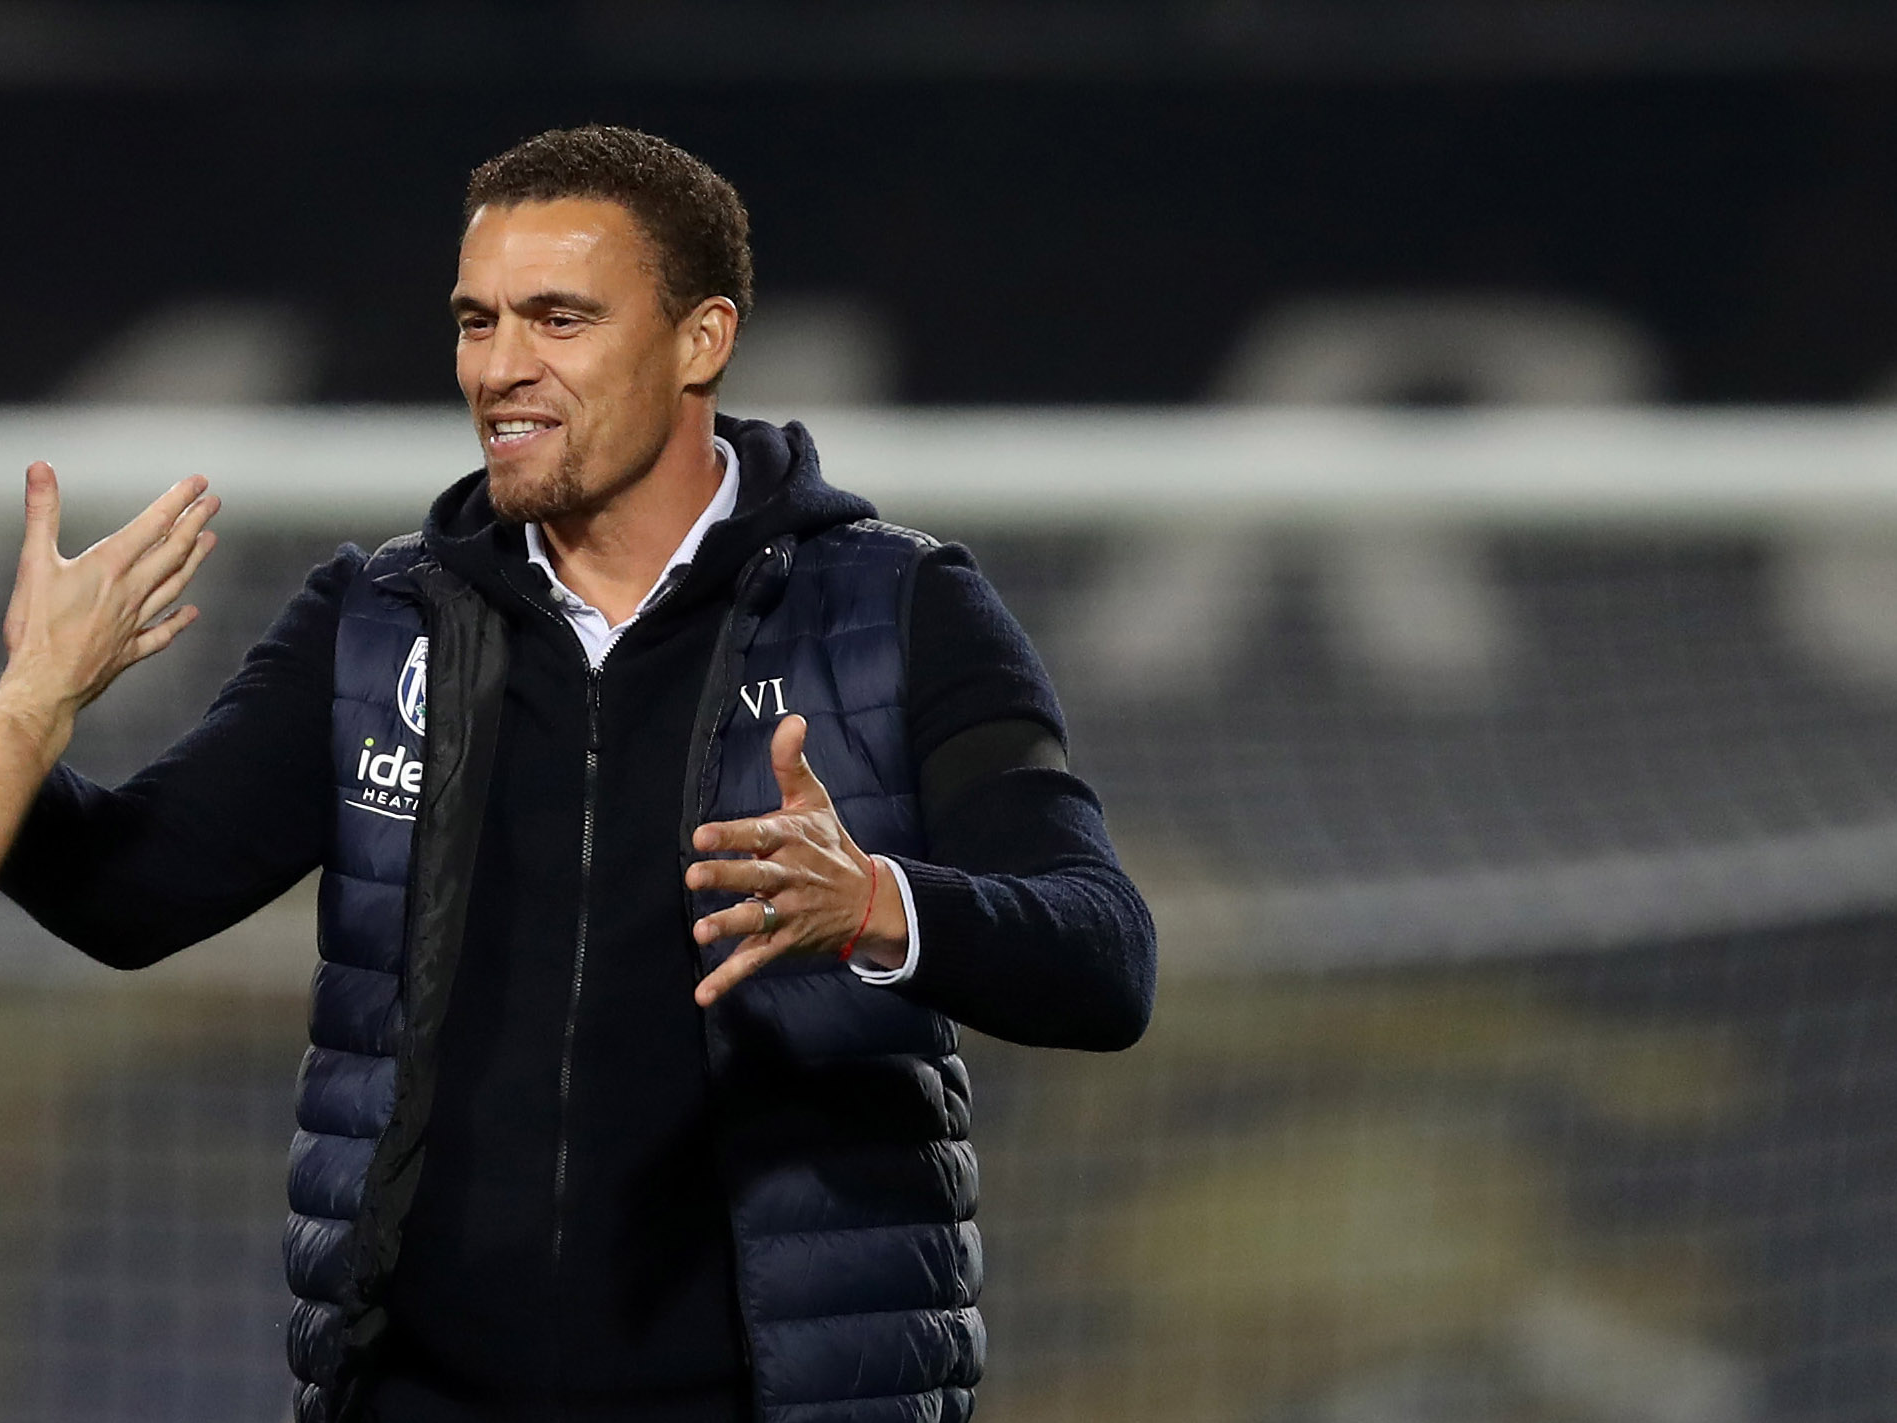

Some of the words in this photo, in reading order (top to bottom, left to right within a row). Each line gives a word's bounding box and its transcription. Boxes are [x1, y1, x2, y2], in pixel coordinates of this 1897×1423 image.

[740, 677, 789, 720] VI
[357, 737, 424, 794] ide
[362, 787, 420, 812] HEATI
